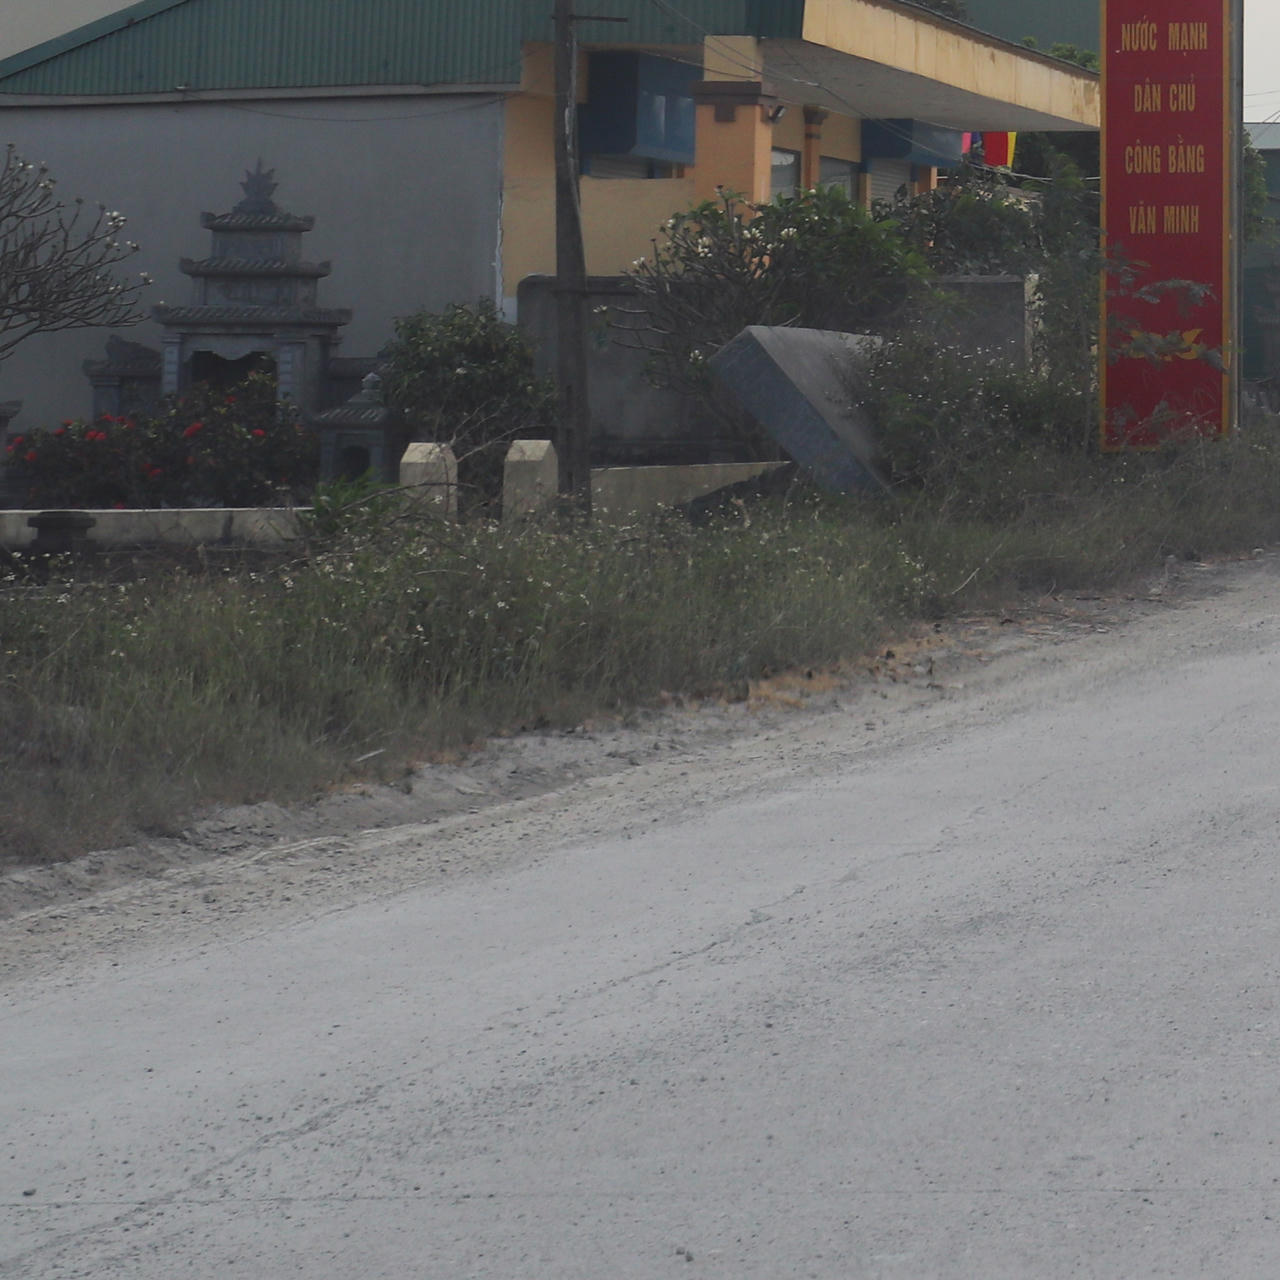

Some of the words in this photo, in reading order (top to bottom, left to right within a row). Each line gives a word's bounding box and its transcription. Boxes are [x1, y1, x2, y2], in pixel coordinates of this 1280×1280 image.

[1121, 15, 1158, 52] NƯỚC
[1168, 22, 1208, 56] MẠNH
[1134, 78, 1162, 112] DÂN
[1169, 74, 1196, 112] CHỦ
[1125, 139, 1161, 174] CÔNG
[1168, 134, 1205, 174] BẰNG
[1164, 205, 1199, 233] MINH
